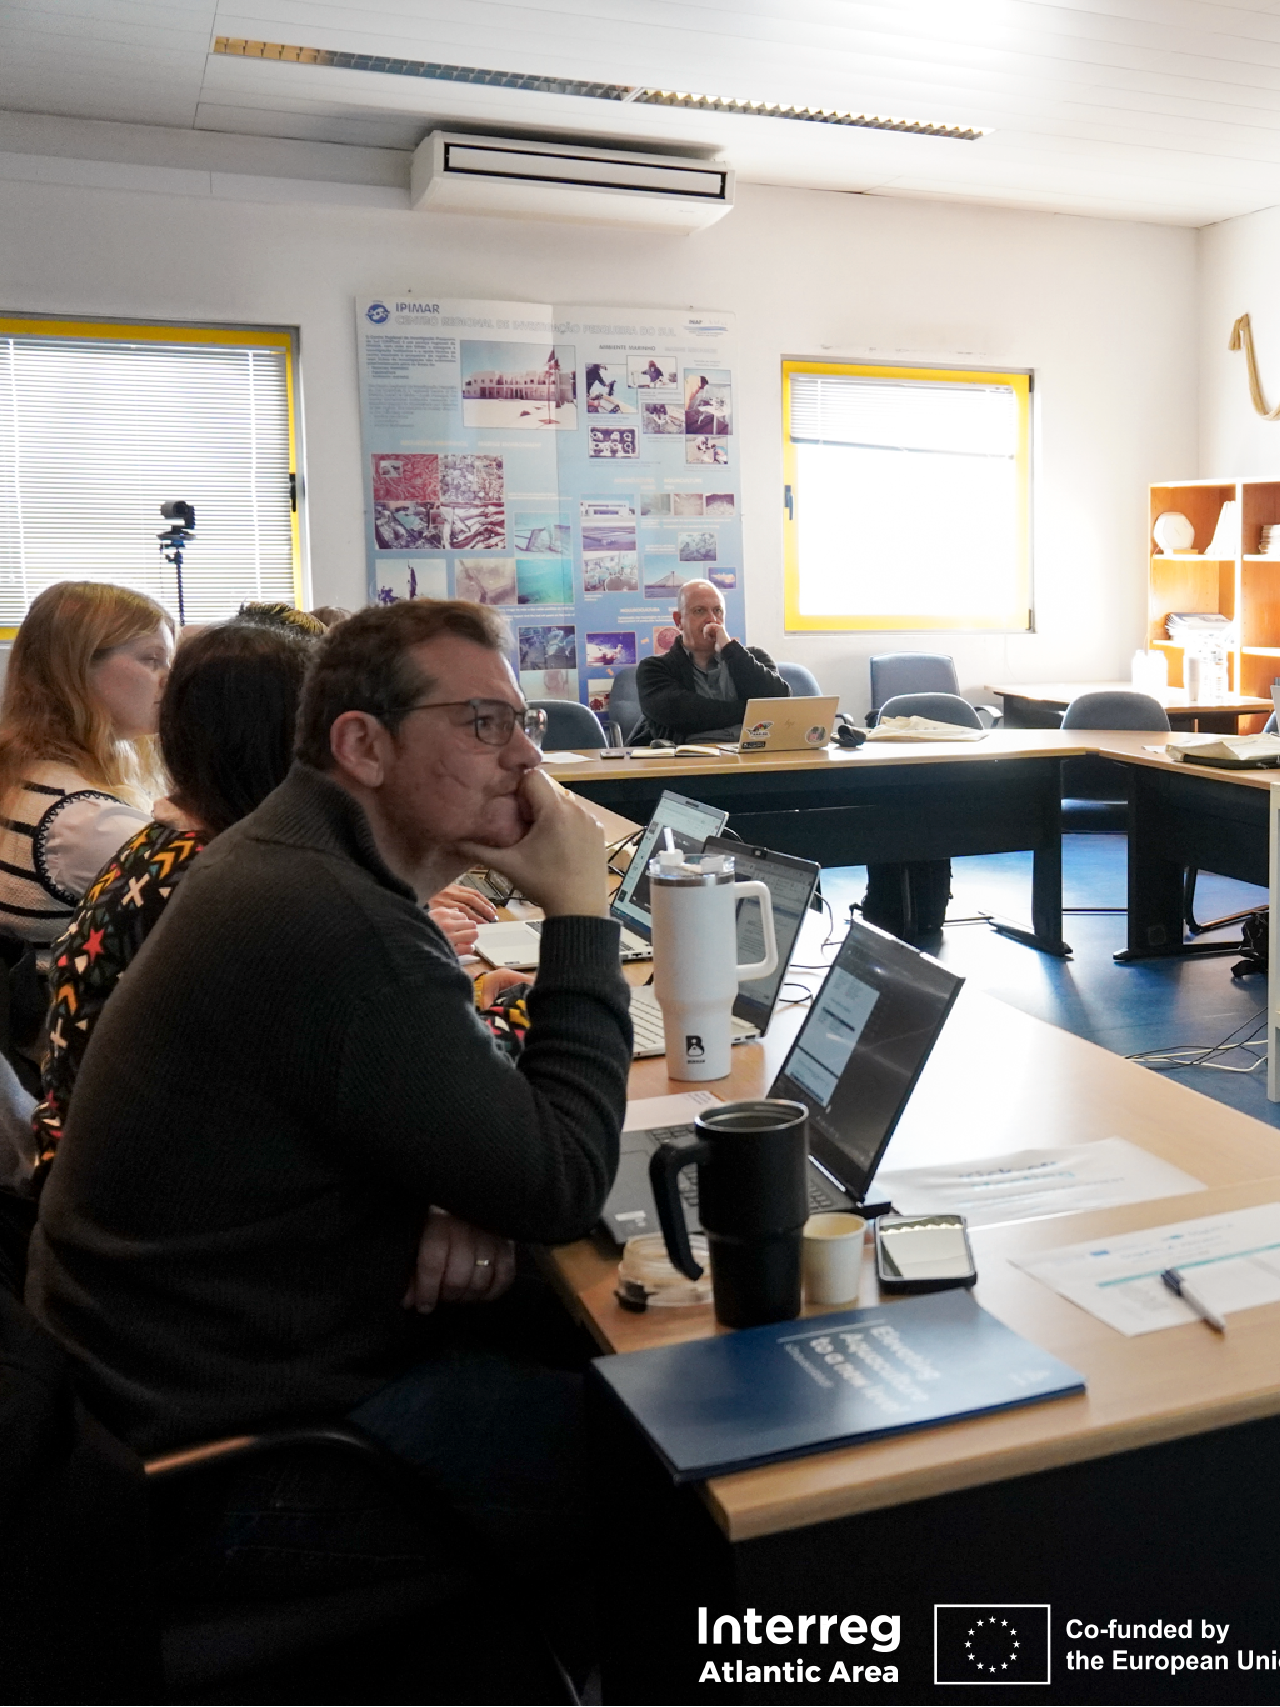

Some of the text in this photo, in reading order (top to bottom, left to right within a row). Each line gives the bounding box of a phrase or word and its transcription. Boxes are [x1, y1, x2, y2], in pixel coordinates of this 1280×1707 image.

[395, 302, 440, 314] IPIMAR
[395, 315, 439, 327] CENTRO
[441, 316, 495, 329] REGIONAL
[496, 319, 510, 330] DE
